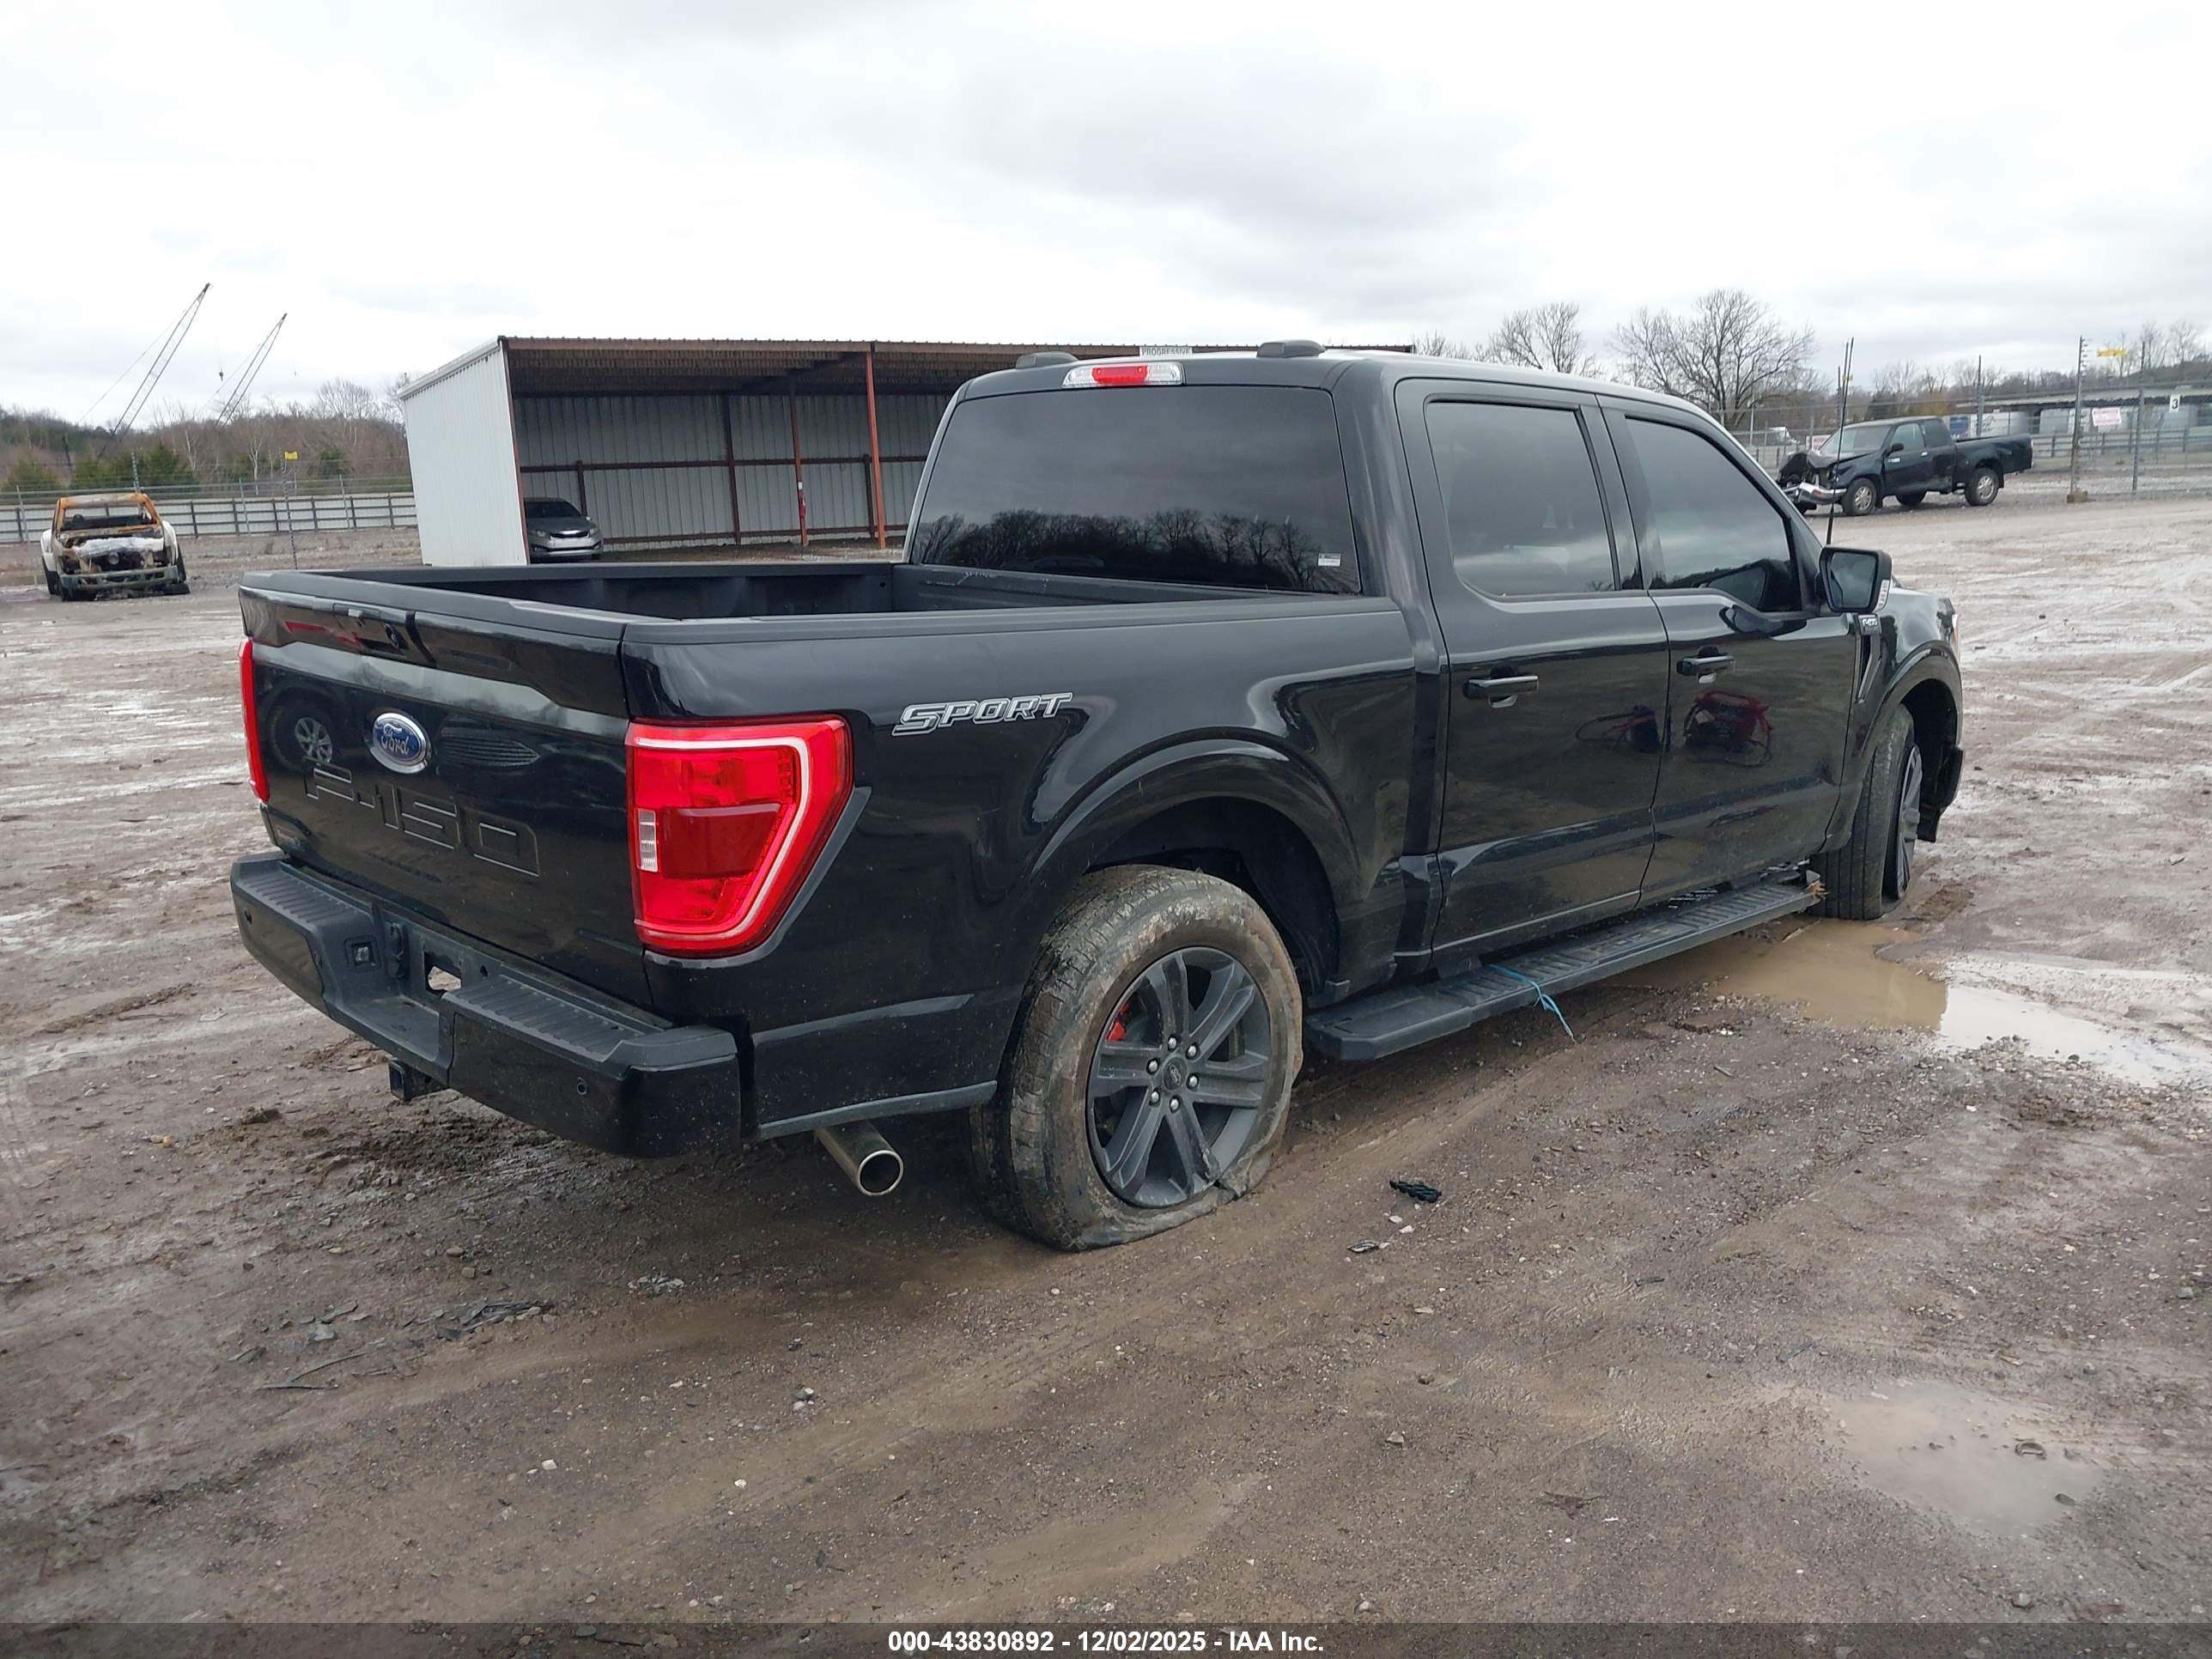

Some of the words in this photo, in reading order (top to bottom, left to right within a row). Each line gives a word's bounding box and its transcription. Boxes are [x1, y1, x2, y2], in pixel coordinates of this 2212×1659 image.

[1141, 346, 1190, 356] PROGRESSIVE
[2172, 398, 2179, 409] 3
[891, 692, 1073, 737] SPORT
[380, 722, 410, 757] Ford
[302, 756, 541, 878] F-150
